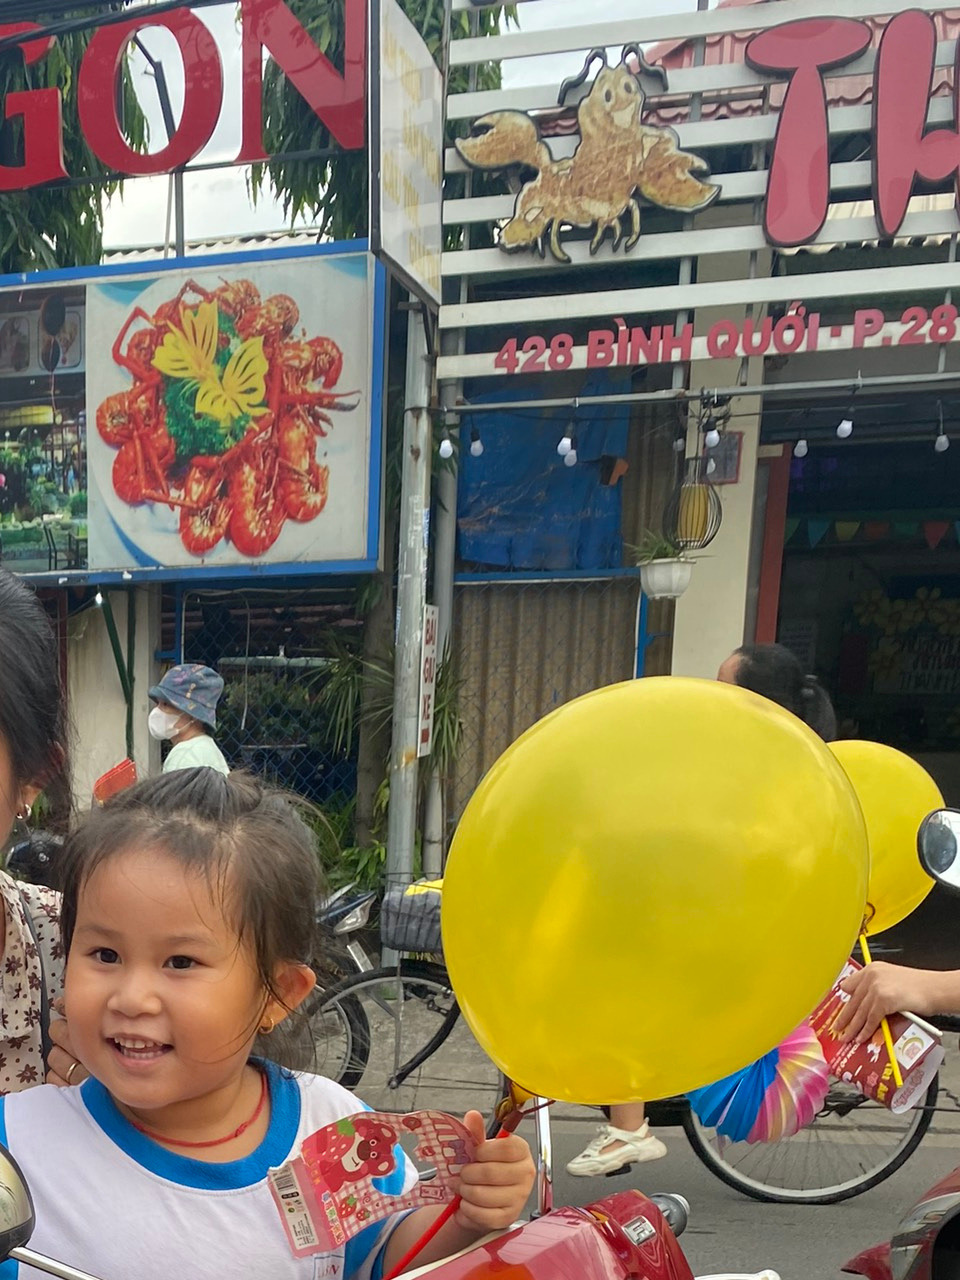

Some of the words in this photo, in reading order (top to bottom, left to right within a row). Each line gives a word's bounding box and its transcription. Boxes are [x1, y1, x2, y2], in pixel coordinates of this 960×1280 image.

[494, 333, 573, 373] 428
[586, 316, 693, 368] BÌNH
[706, 300, 820, 359] QUỚI
